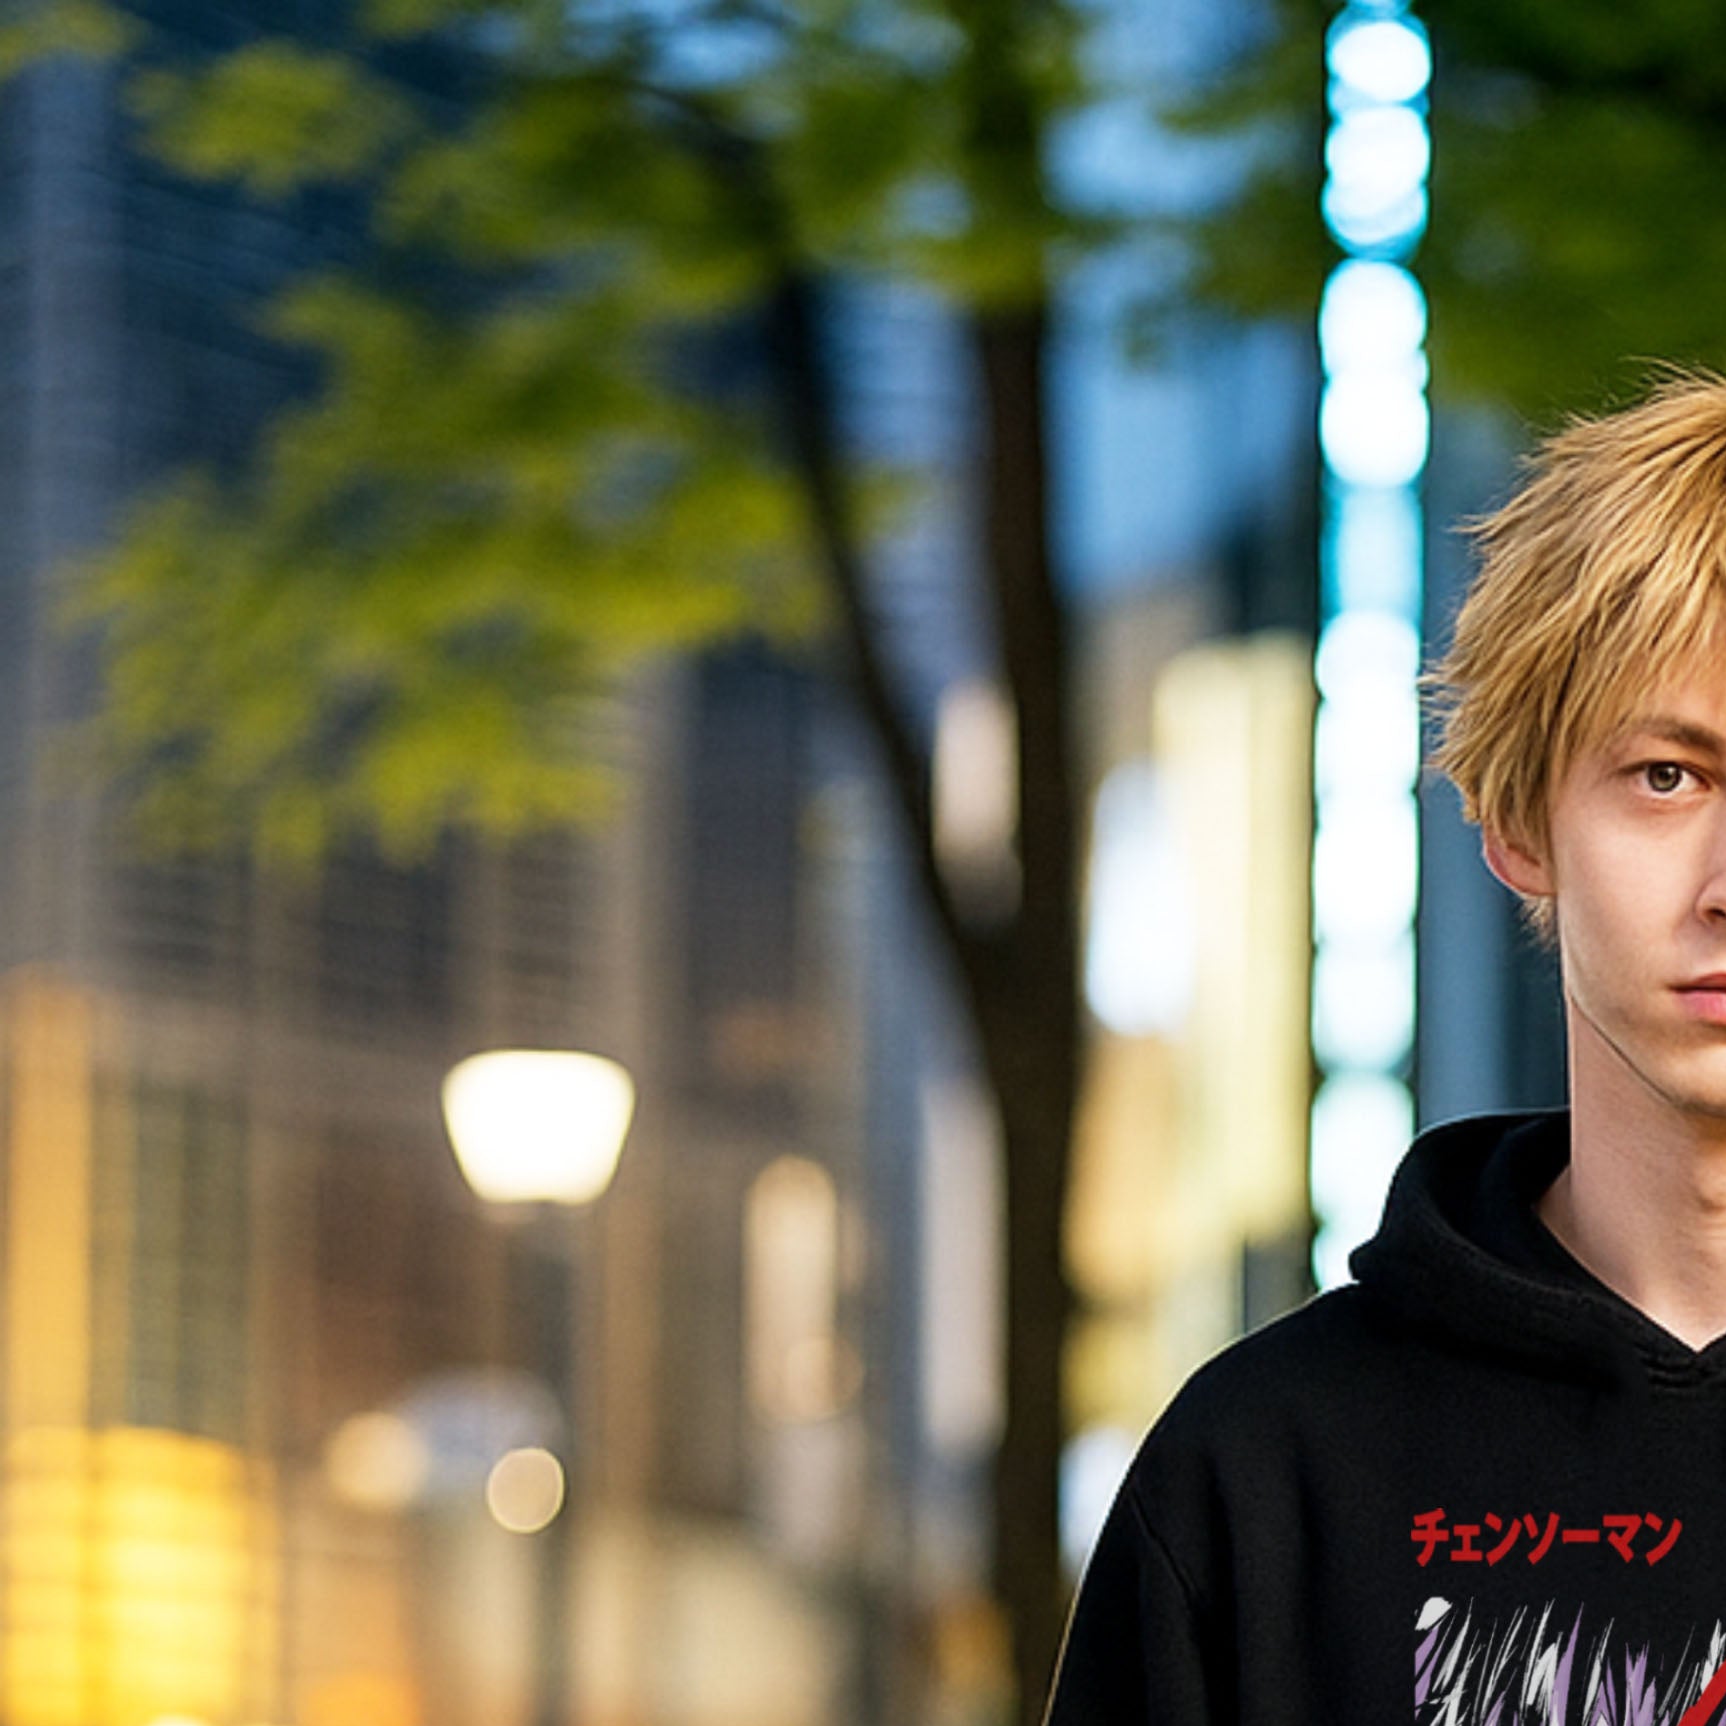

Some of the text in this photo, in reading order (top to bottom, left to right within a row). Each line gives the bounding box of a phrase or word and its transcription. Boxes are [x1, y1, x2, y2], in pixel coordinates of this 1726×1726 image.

[1410, 1507, 1683, 1567] チェンソーマン
